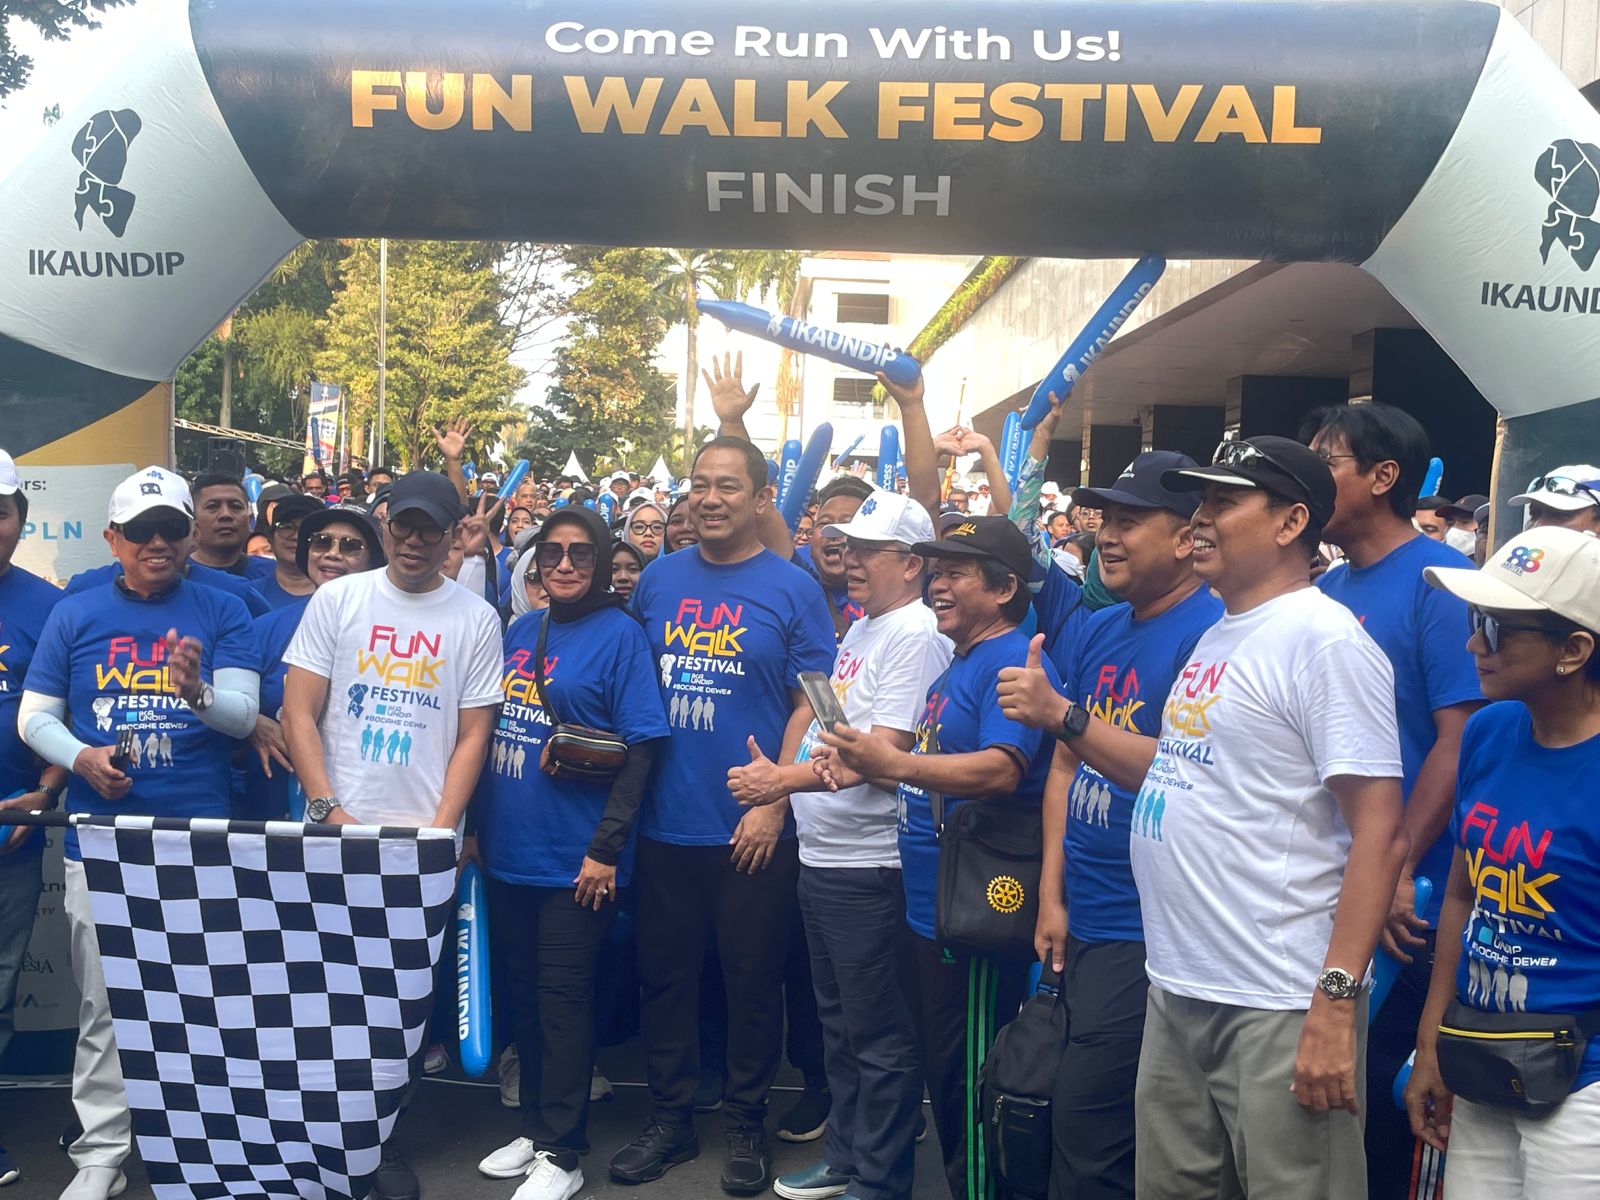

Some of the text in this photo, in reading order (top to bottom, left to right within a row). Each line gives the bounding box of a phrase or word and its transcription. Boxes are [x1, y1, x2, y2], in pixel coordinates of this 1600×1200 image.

[545, 21, 1121, 61] Come Run With Us!
[351, 70, 1322, 144] FUN WALK FESTIVAL
[706, 171, 951, 217] FINISH
[29, 249, 185, 278] IKAUNDIP
[1079, 282, 1152, 366] IKAUNDIP
[790, 319, 897, 367] IKAUNDIP
[21, 480, 47, 491] rs:
[883, 463, 893, 491] ccess
[21, 521, 82, 540] PLN
[675, 598, 743, 628] FUN
[368, 624, 442, 659] FUN
[664, 621, 748, 657] WALK
[96, 662, 176, 694] WAL
[357, 648, 446, 689] WALK
[677, 655, 745, 675] FESTIVAL
[1174, 661, 1228, 698] FUN
[117, 695, 191, 709] FESTIVA
[370, 686, 441, 711] FESTIVAL
[705, 686, 732, 695] DEWE#
[502, 702, 552, 726] ESTIVAL
[1461, 802, 1553, 869] FUN
[1512, 956, 1558, 967] DEWE#
